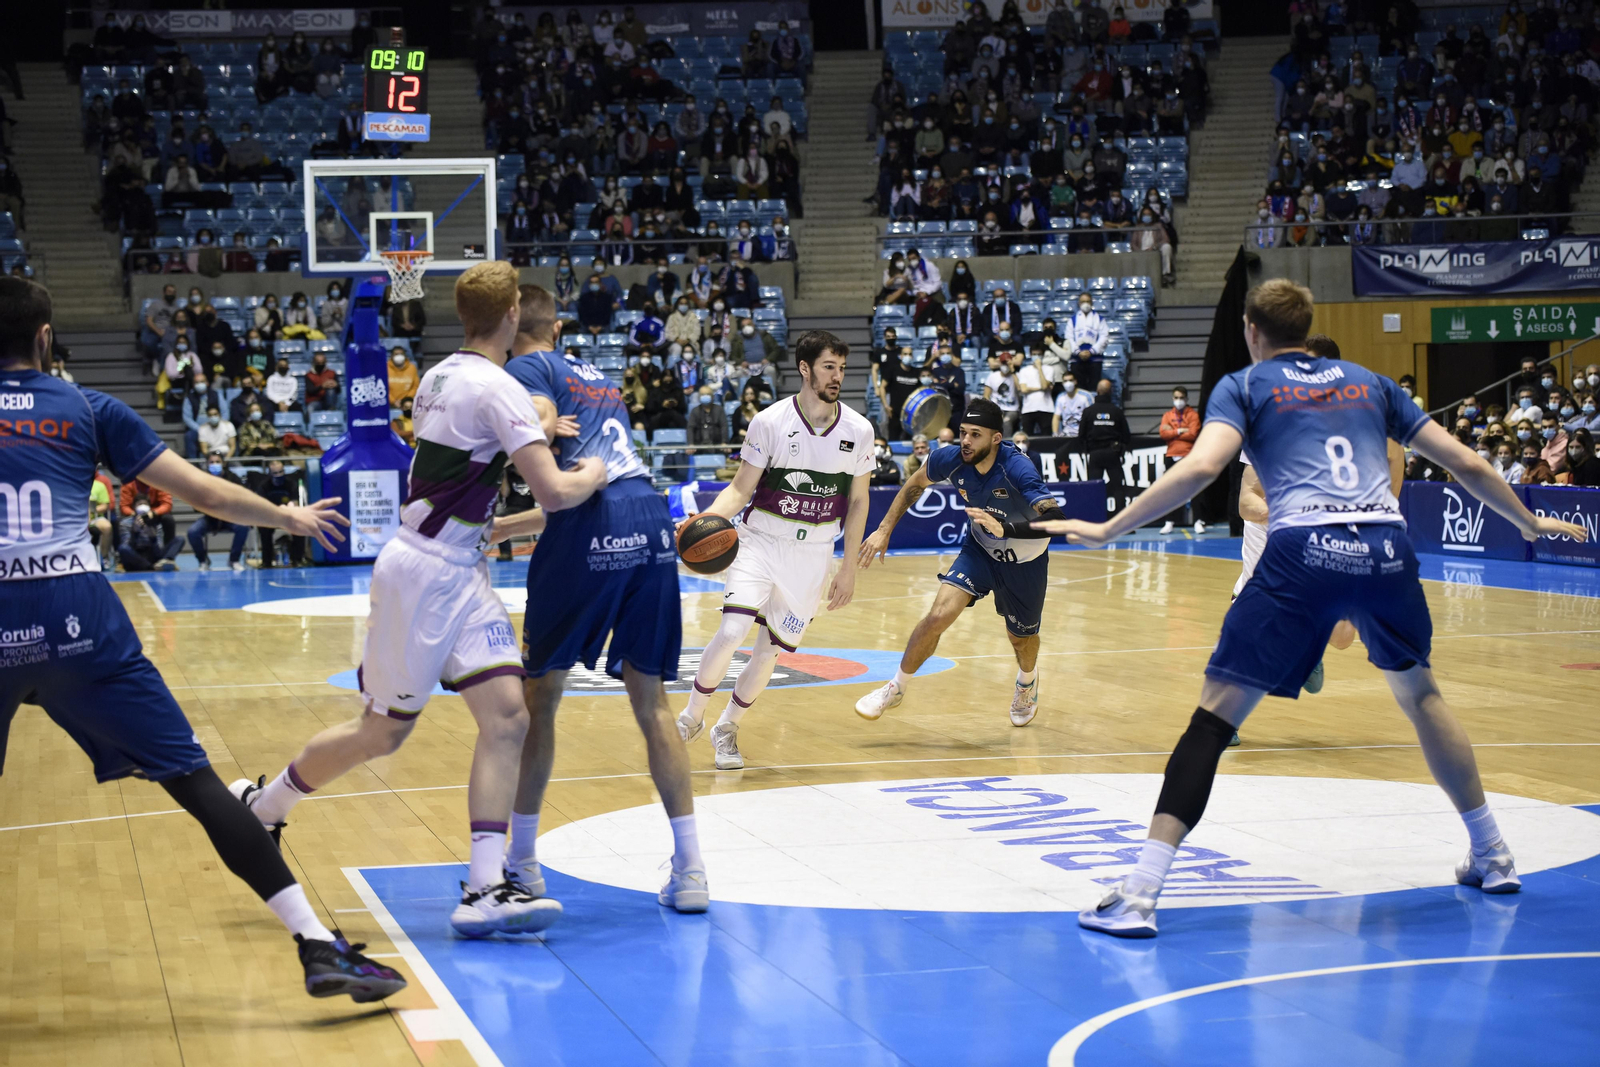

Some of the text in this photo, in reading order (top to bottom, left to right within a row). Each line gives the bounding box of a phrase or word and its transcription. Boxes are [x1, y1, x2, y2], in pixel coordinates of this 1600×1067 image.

[388, 76, 420, 111] 12
[370, 122, 426, 134] PESCAMAR
[1526, 322, 1564, 333] ASEOS
[1282, 365, 1345, 385] ELLENSON
[1293, 384, 1370, 403] cenor
[1325, 436, 1359, 491] 8
[811, 484, 838, 495] Unicaja
[590, 532, 648, 550] A Coruña
[797, 529, 807, 540] 0
[1308, 532, 1370, 554] A Coruña
[590, 561, 608, 571] POR
